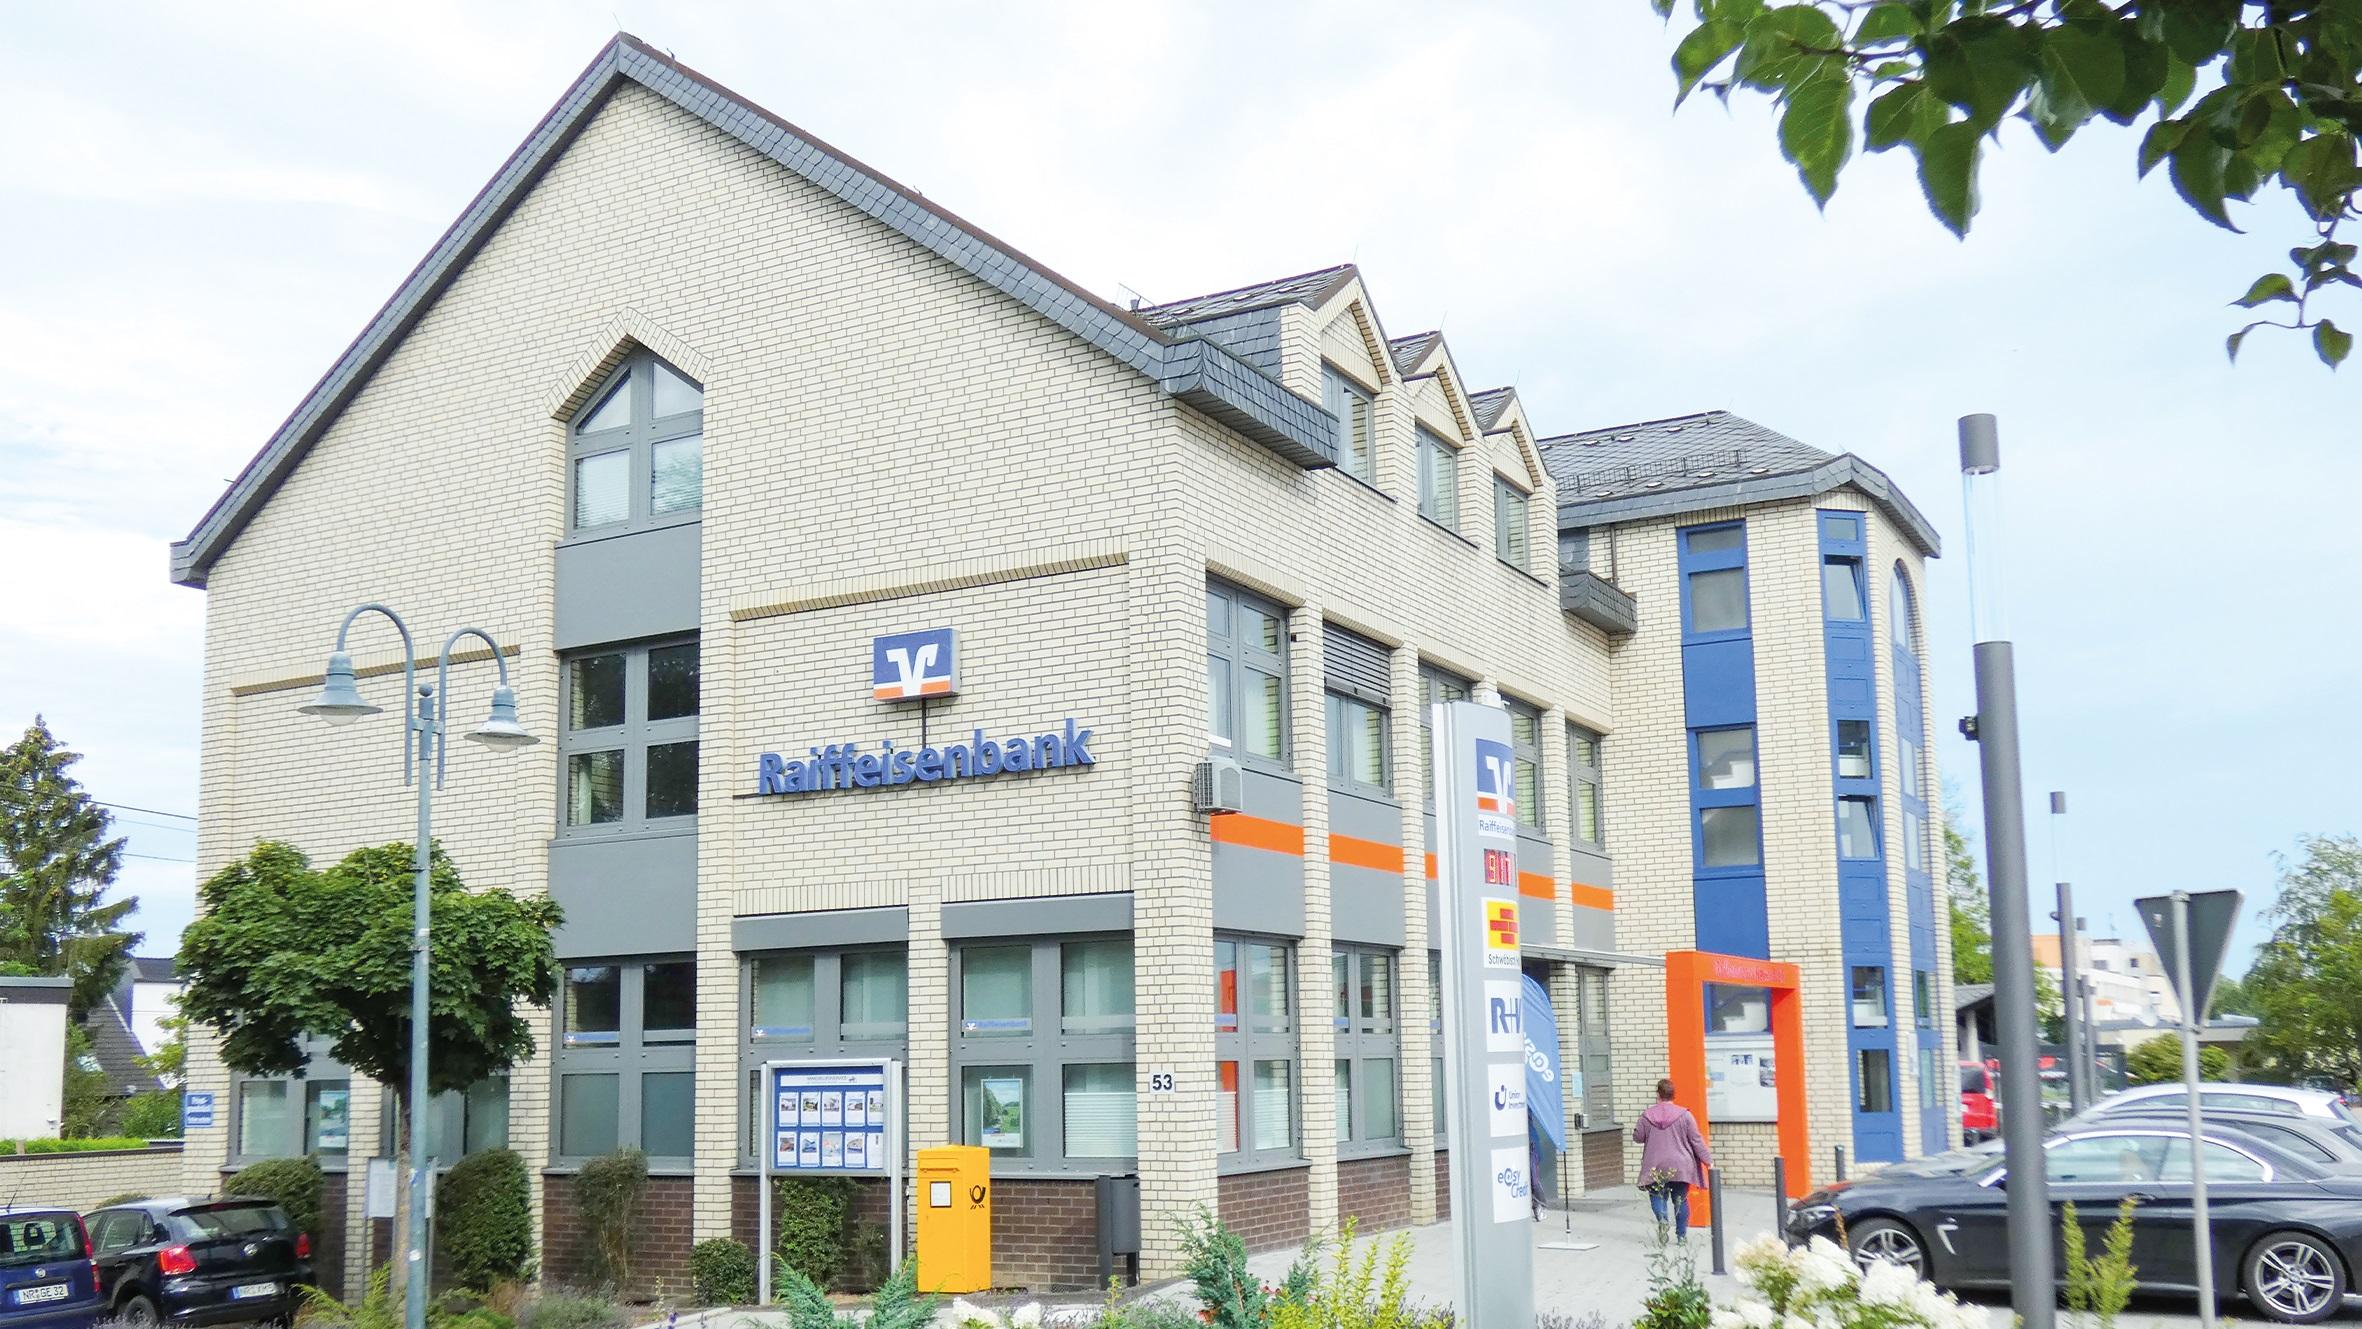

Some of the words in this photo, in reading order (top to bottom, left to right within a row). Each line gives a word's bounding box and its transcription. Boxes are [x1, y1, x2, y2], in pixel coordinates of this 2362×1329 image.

[759, 717, 1095, 795] Raiffeisenbank
[1153, 1074, 1172, 1090] 53
[22, 1288, 35, 1301] NR
[40, 1287, 52, 1298] GE
[54, 1285, 65, 1296] 32
